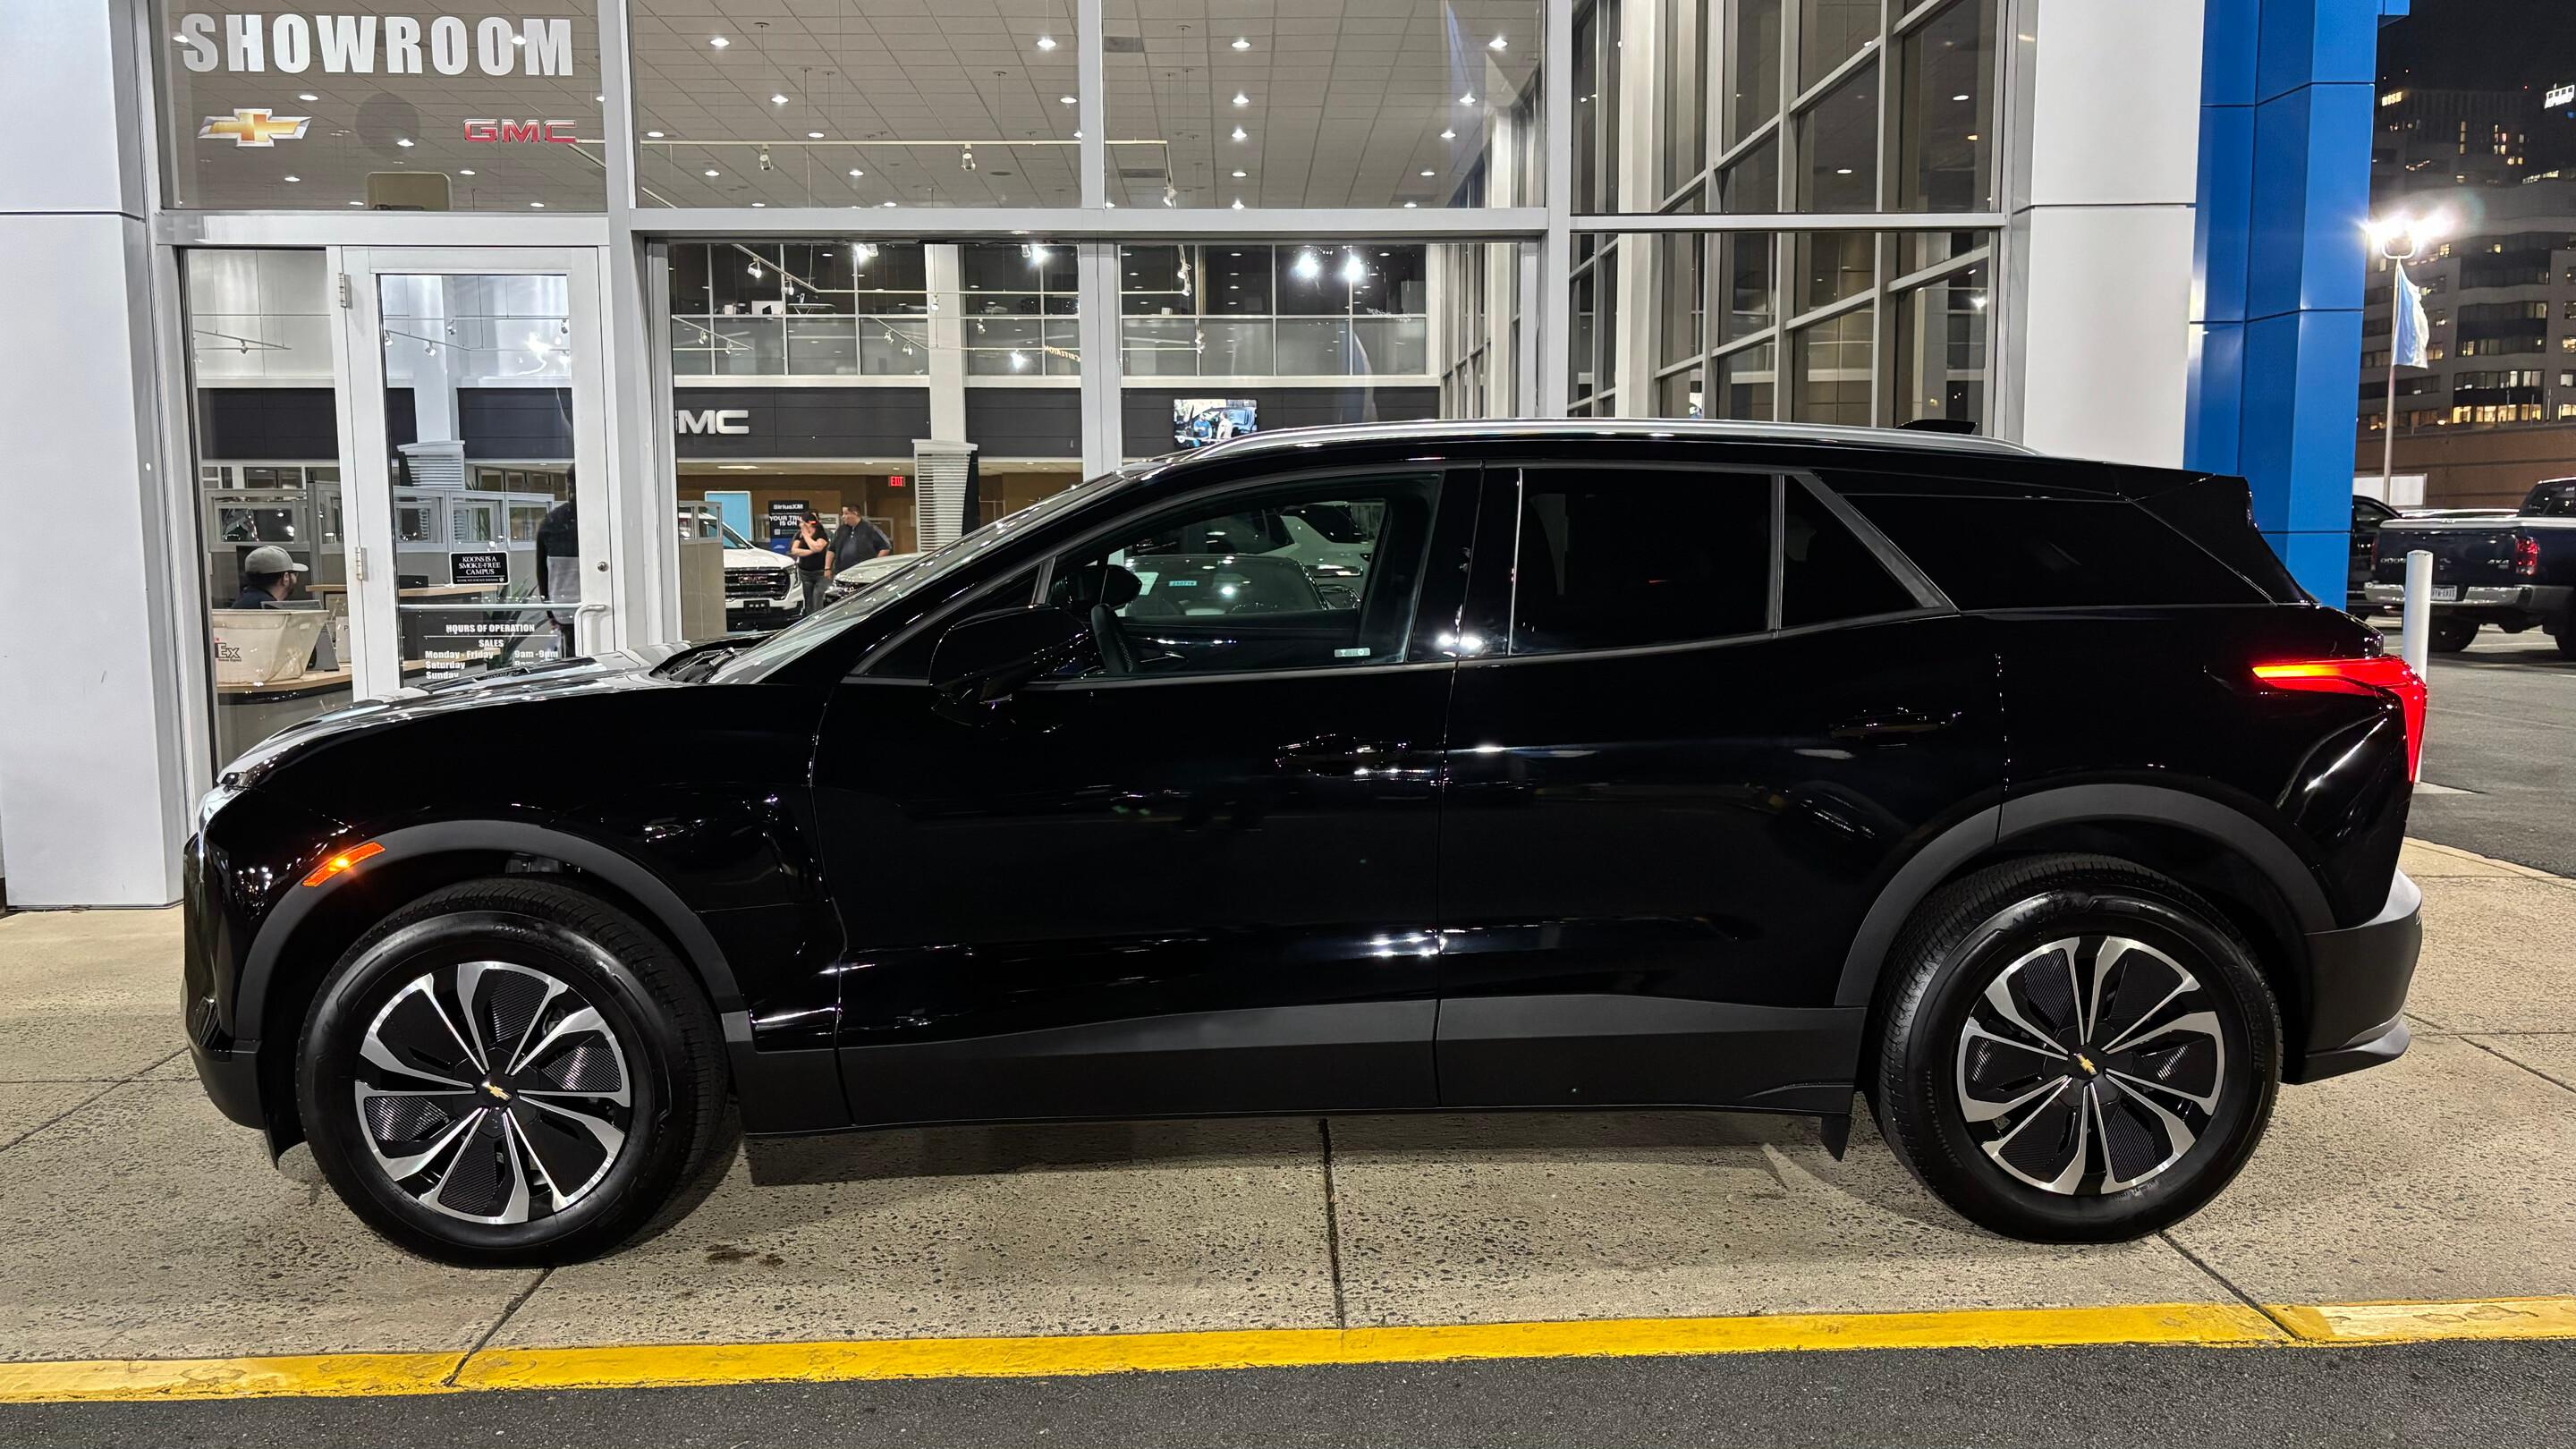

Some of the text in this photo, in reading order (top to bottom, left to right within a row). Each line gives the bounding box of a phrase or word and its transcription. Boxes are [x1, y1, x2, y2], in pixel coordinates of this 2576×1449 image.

[182, 13, 573, 77] SHOWROOM
[462, 118, 577, 144] GMC
[674, 410, 750, 435] MC
[890, 476, 903, 487] EXIT
[445, 623, 535, 633] HOURS OF OPERATION
[479, 639, 504, 648] SALES
[425, 650, 460, 659] Monday
[466, 650, 494, 659] Friday
[513, 649, 534, 658] 9am
[425, 661, 466, 670] Saturday
[426, 671, 459, 680] Sunday
